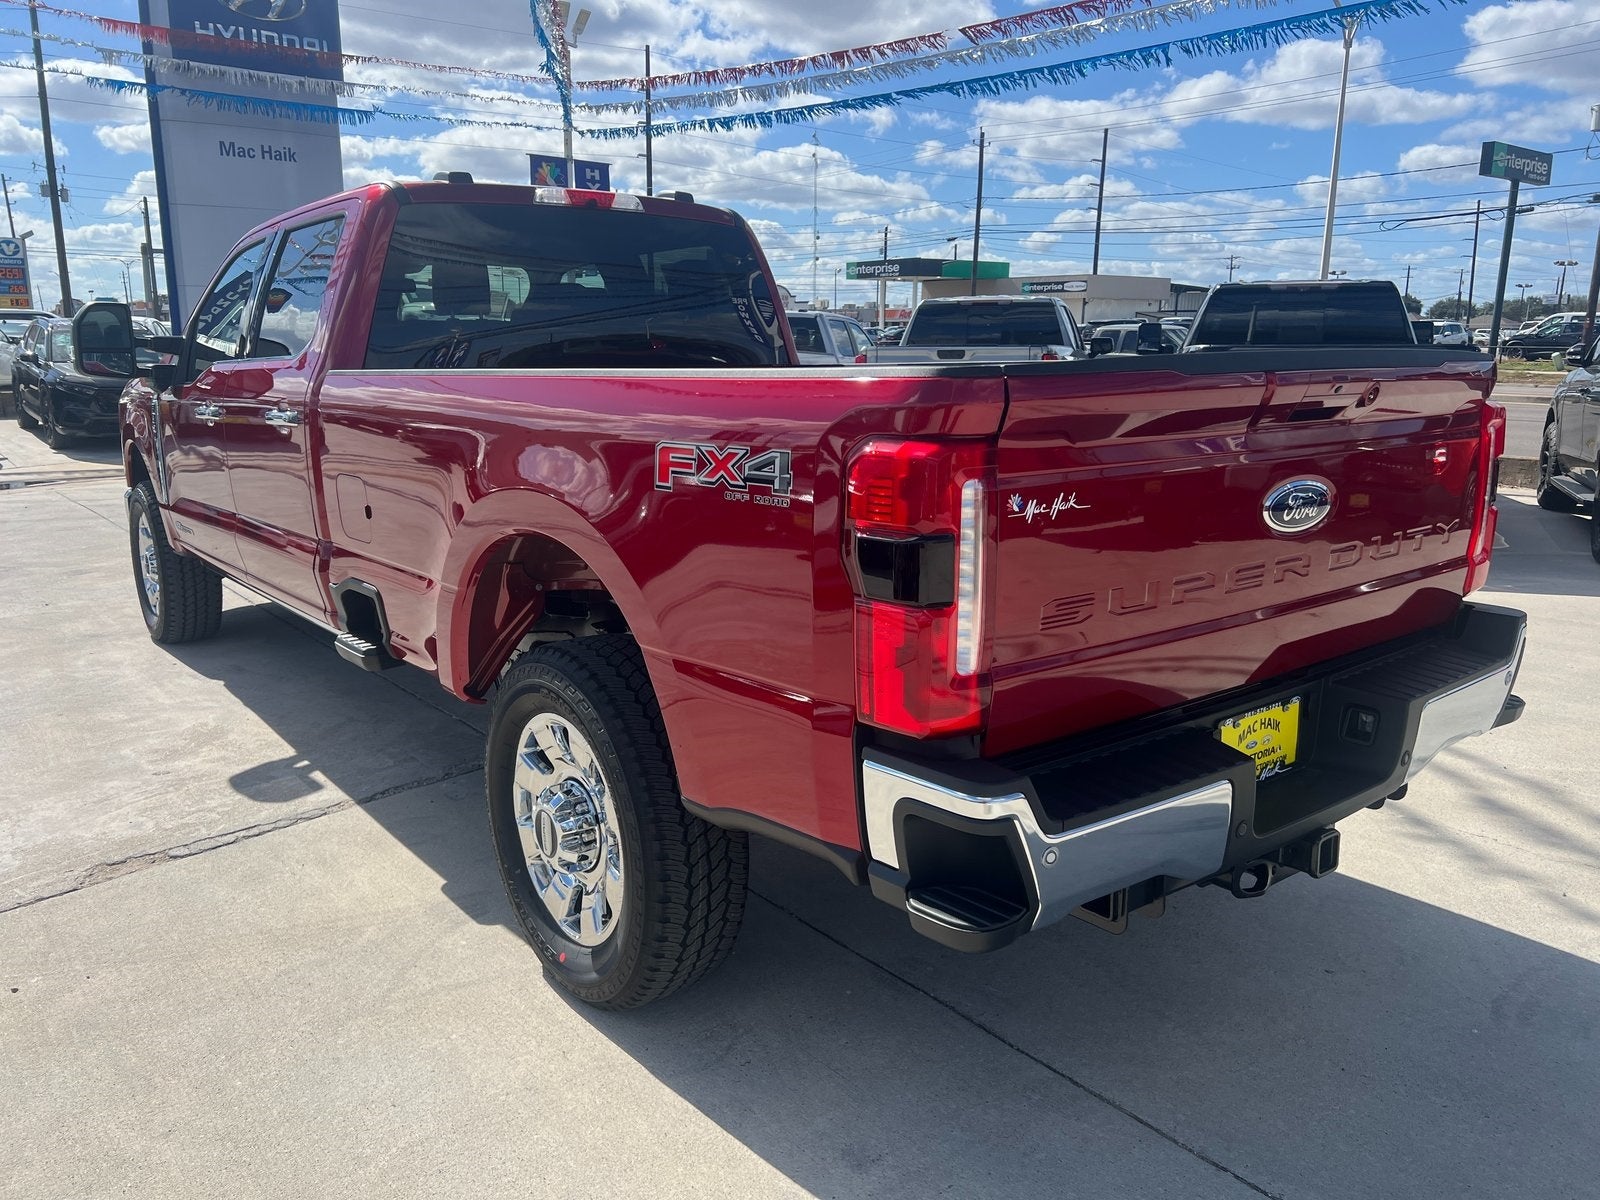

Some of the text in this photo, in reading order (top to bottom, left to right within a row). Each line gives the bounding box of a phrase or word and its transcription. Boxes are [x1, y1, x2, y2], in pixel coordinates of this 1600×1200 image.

[194, 21, 328, 53] HYUNDAI
[219, 140, 297, 163] Mac Haik
[1496, 152, 1548, 175] enterprise
[848, 262, 900, 276] enterprise
[1023, 282, 1063, 292] enterprise
[654, 440, 793, 497] FX4
[724, 491, 790, 507] OFF ROAD
[1008, 492, 1091, 523] Mac Haik
[1283, 492, 1319, 521] Ford
[1039, 518, 1461, 631] SUPER DUTY
[1238, 717, 1281, 746] MAC HAIK
